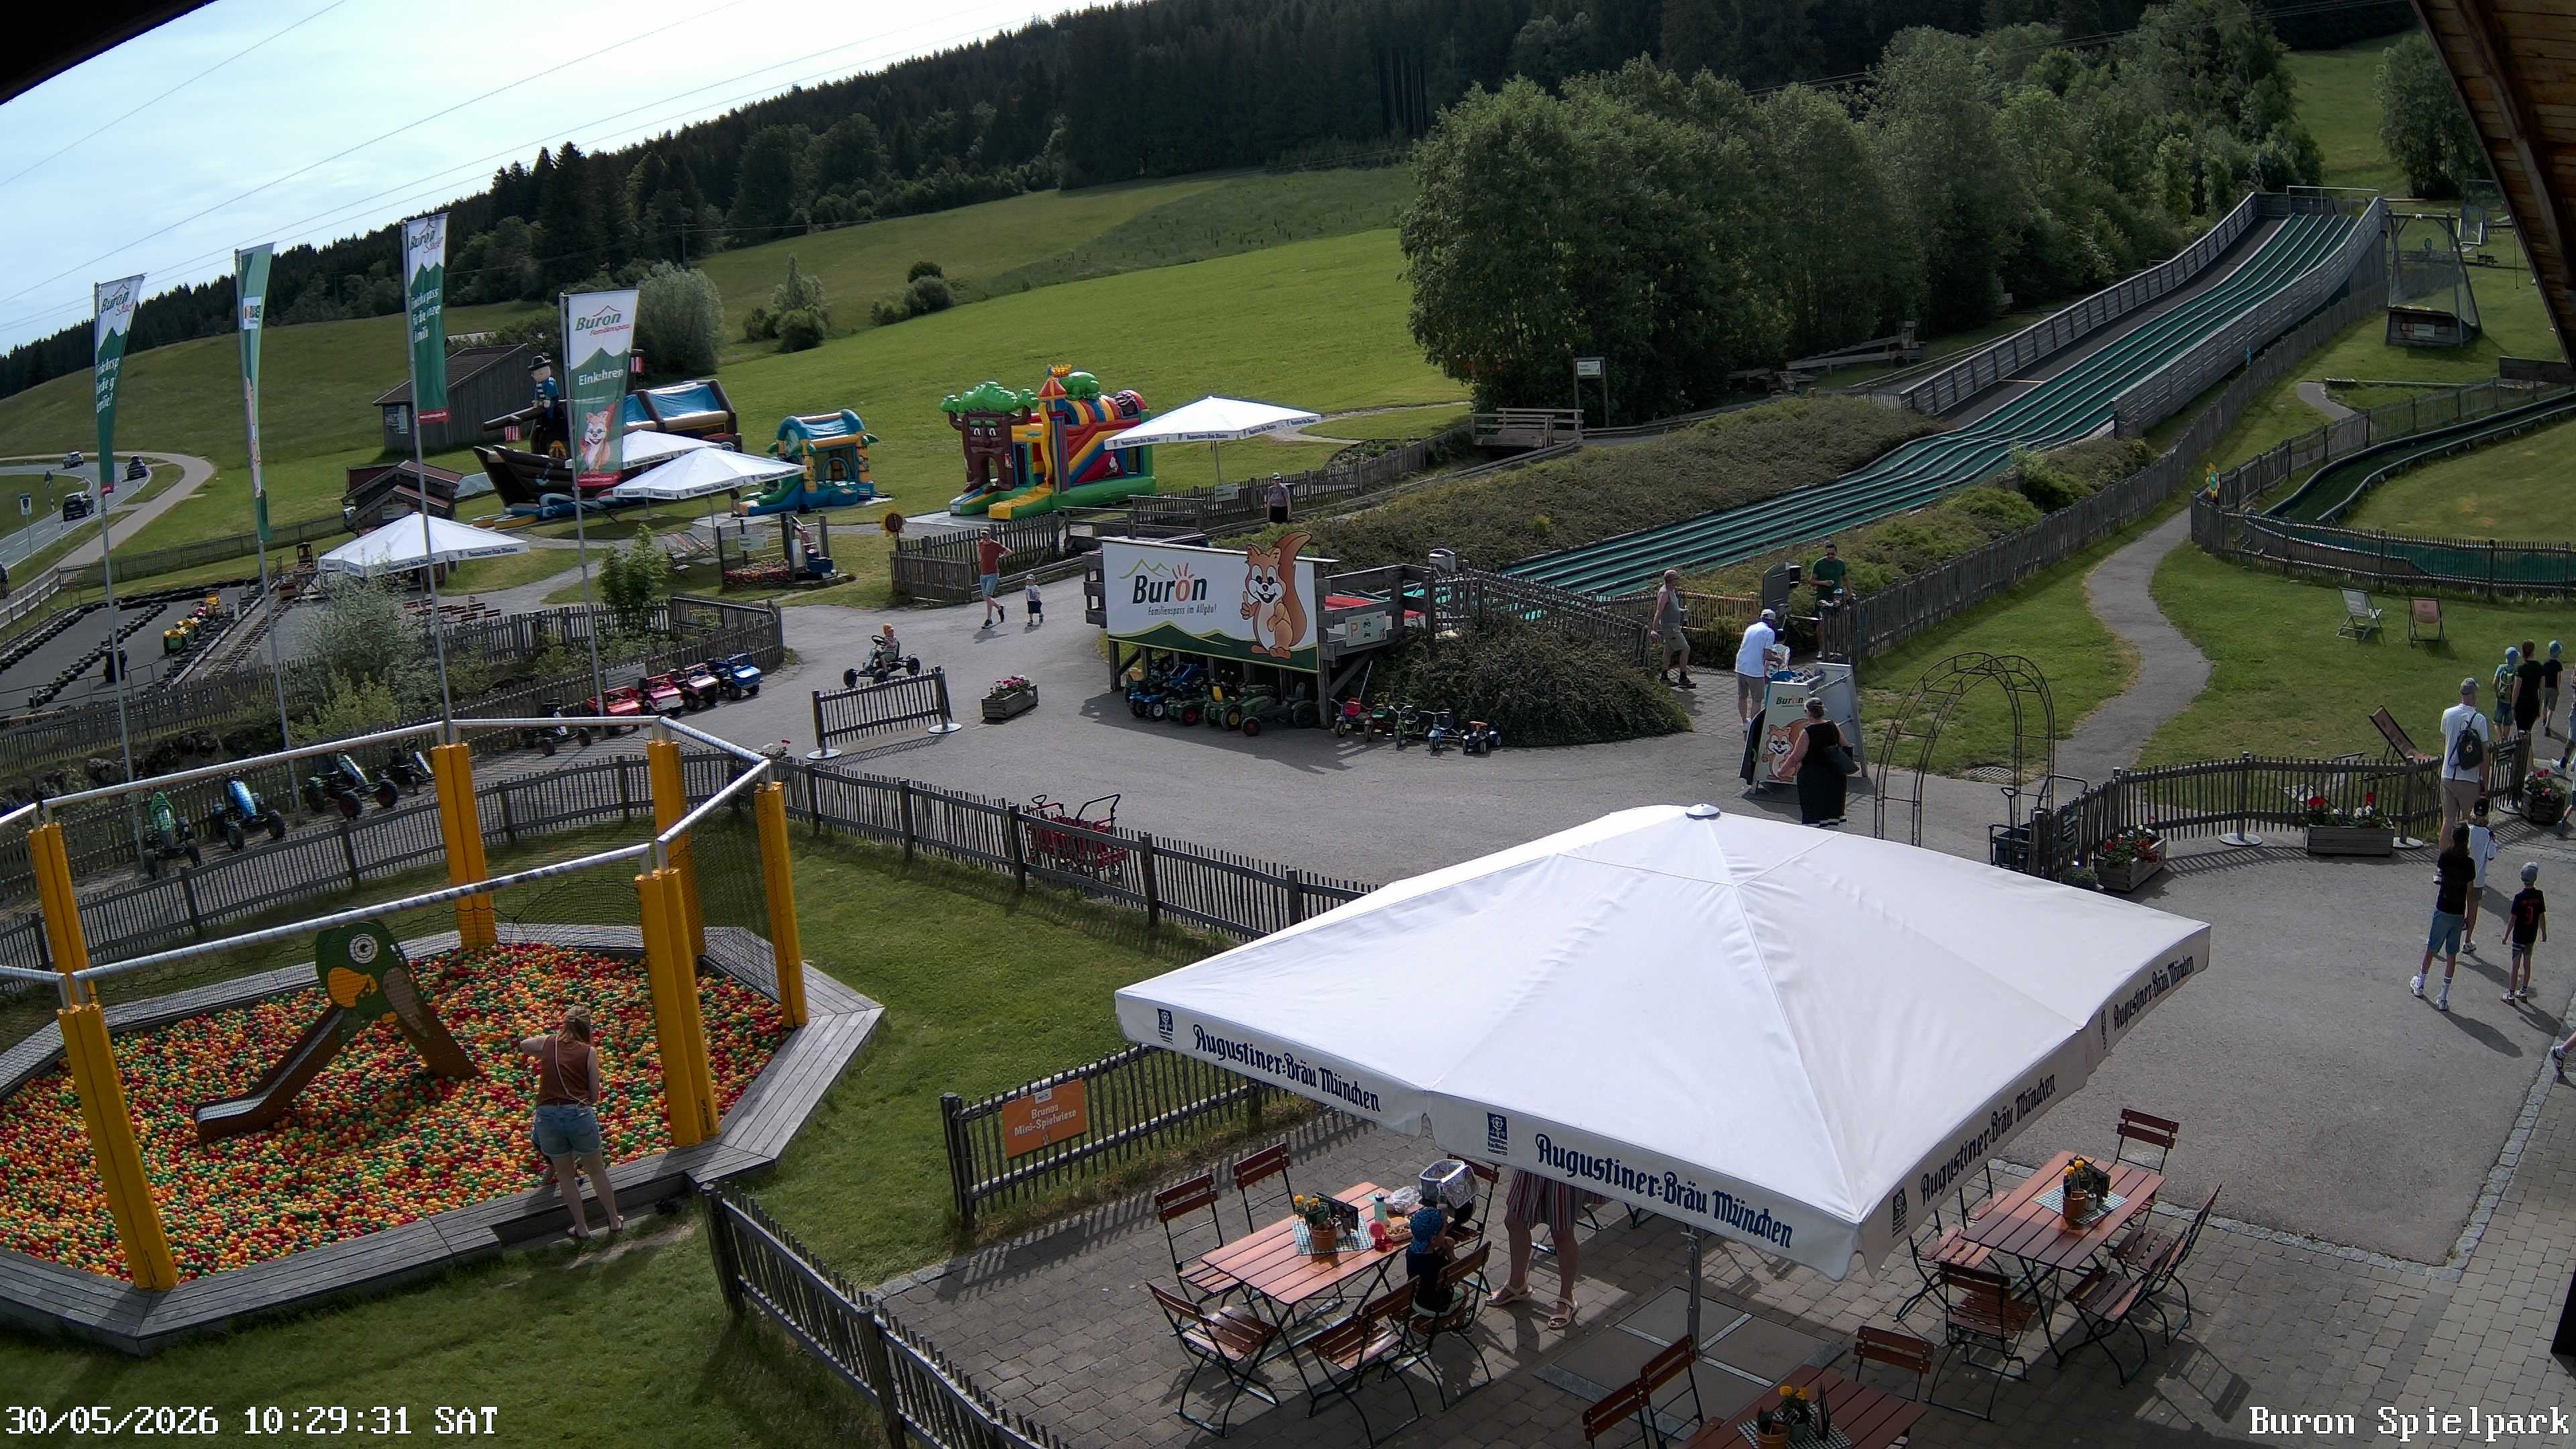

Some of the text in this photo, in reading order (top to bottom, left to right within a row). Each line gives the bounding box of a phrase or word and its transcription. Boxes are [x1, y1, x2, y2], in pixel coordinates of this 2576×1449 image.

[574, 313, 621, 331] Buron
[1132, 574, 1208, 604] Buron
[1187, 606, 1194, 614] im
[1318, 1067, 1381, 1113] München
[2015, 1073, 2057, 1123] München
[1712, 1190, 1793, 1248] München
